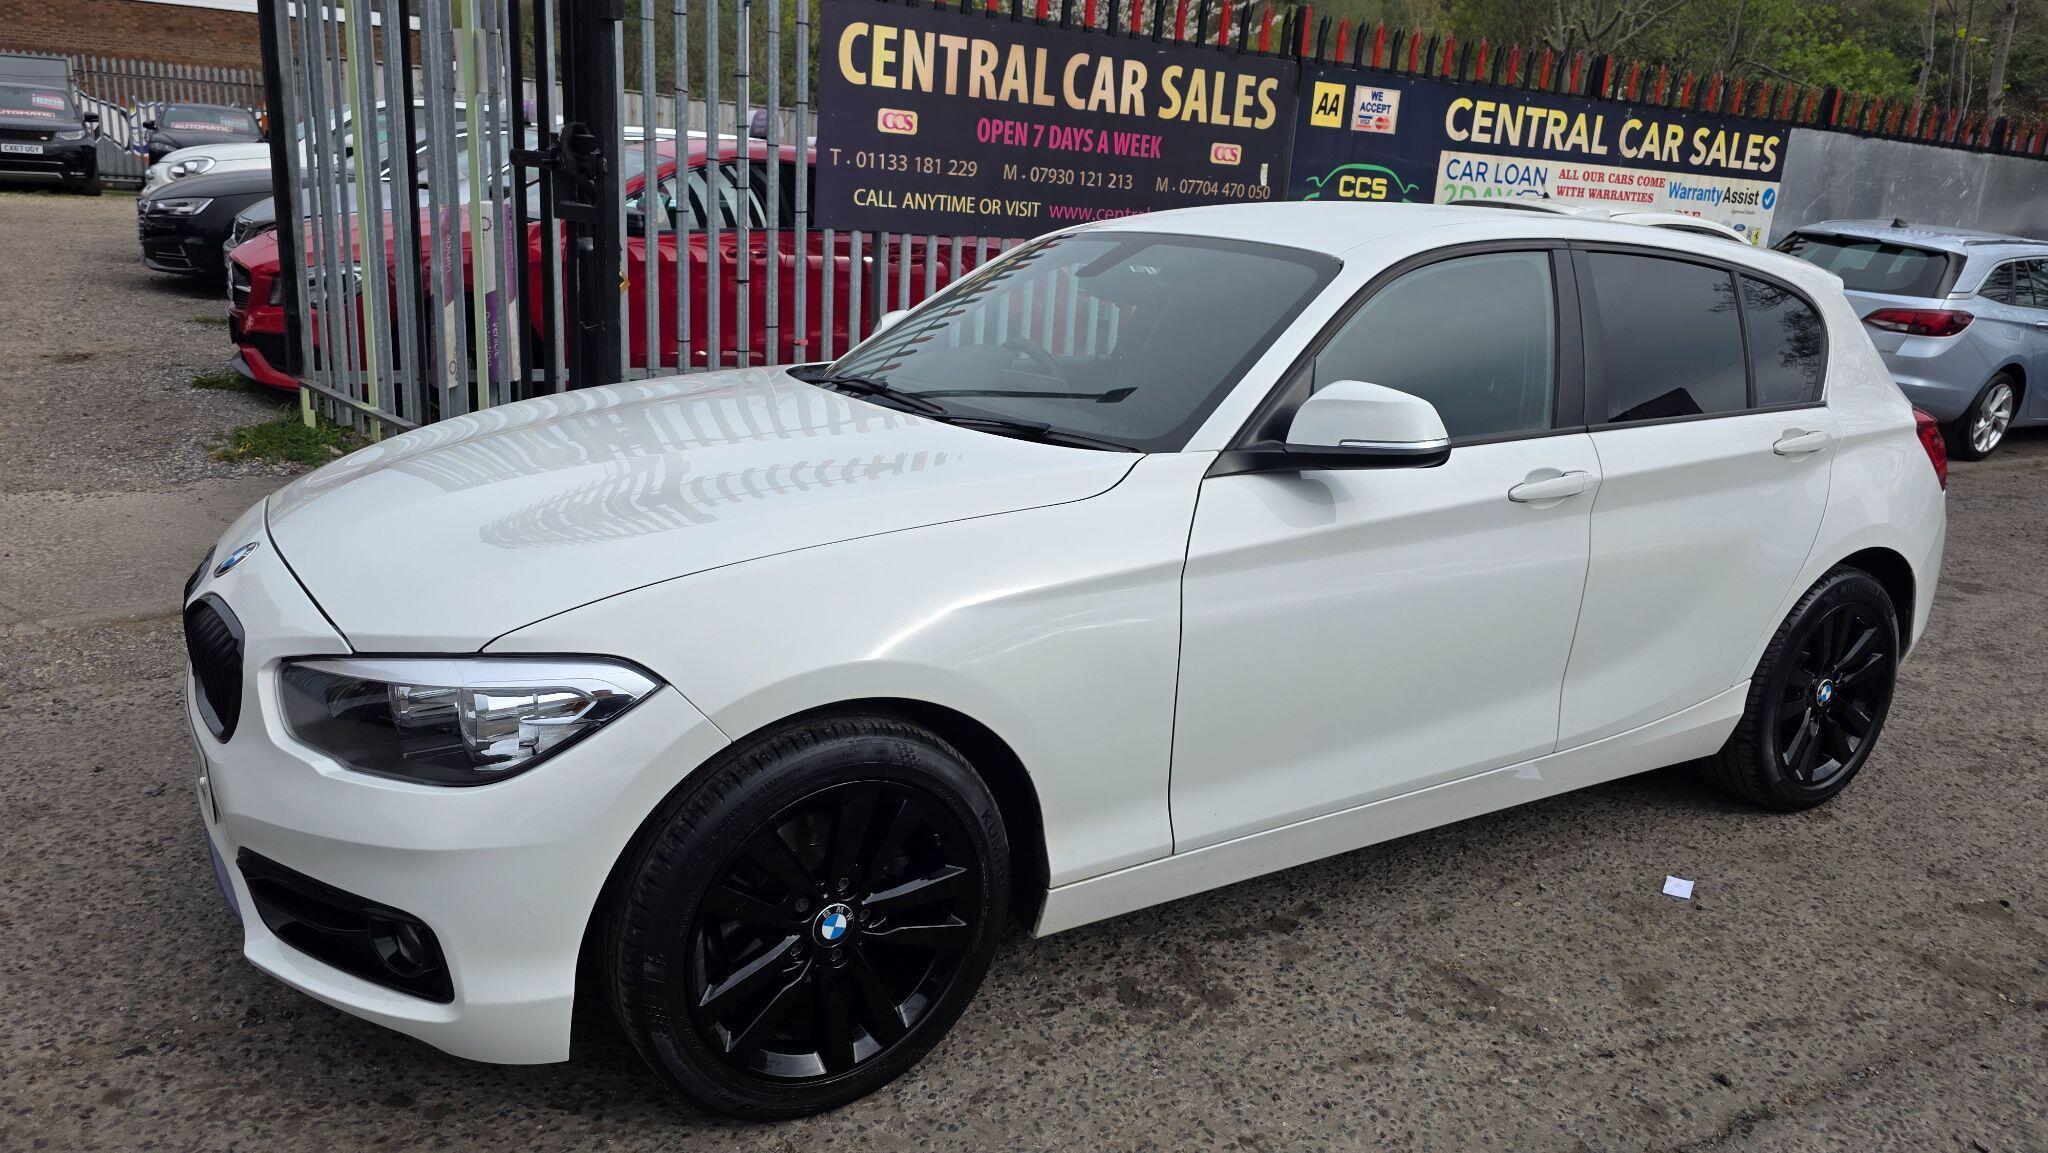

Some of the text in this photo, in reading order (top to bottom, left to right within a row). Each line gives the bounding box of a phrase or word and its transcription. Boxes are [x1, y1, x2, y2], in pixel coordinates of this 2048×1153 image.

[838, 21, 1279, 130] CENTRAL CAR SALES
[1315, 92, 1340, 117] AA
[1371, 90, 1384, 102] WE
[1360, 102, 1391, 115] ACCEPT
[173, 122, 232, 132] AUTOMATIC
[882, 112, 914, 131] CCS
[977, 117, 1163, 159] OPEN 7 DAYS A WEEK
[1445, 97, 1781, 173] CENTRAL CAR SALES
[856, 151, 908, 172] 01133
[915, 156, 941, 175] 181
[947, 159, 978, 177] 229
[1214, 146, 1238, 162] CCS
[1030, 166, 1074, 185] 07930
[1079, 170, 1102, 187] 121
[1108, 173, 1133, 190] 213
[1446, 158, 1548, 186] CAR LOAN
[1559, 169, 1666, 188] ALL OUR CARS COME
[1180, 179, 1218, 196] 07704
[1222, 183, 1244, 198] 470
[1248, 185, 1271, 200] 050
[1338, 175, 1388, 200] CCS
[1556, 185, 1654, 203] WITH WARRANTIES
[853, 188, 897, 208] CALL
[902, 192, 975, 214] ANYTIME
[979, 198, 1001, 215] OR
[1005, 199, 1041, 218] VISIT
